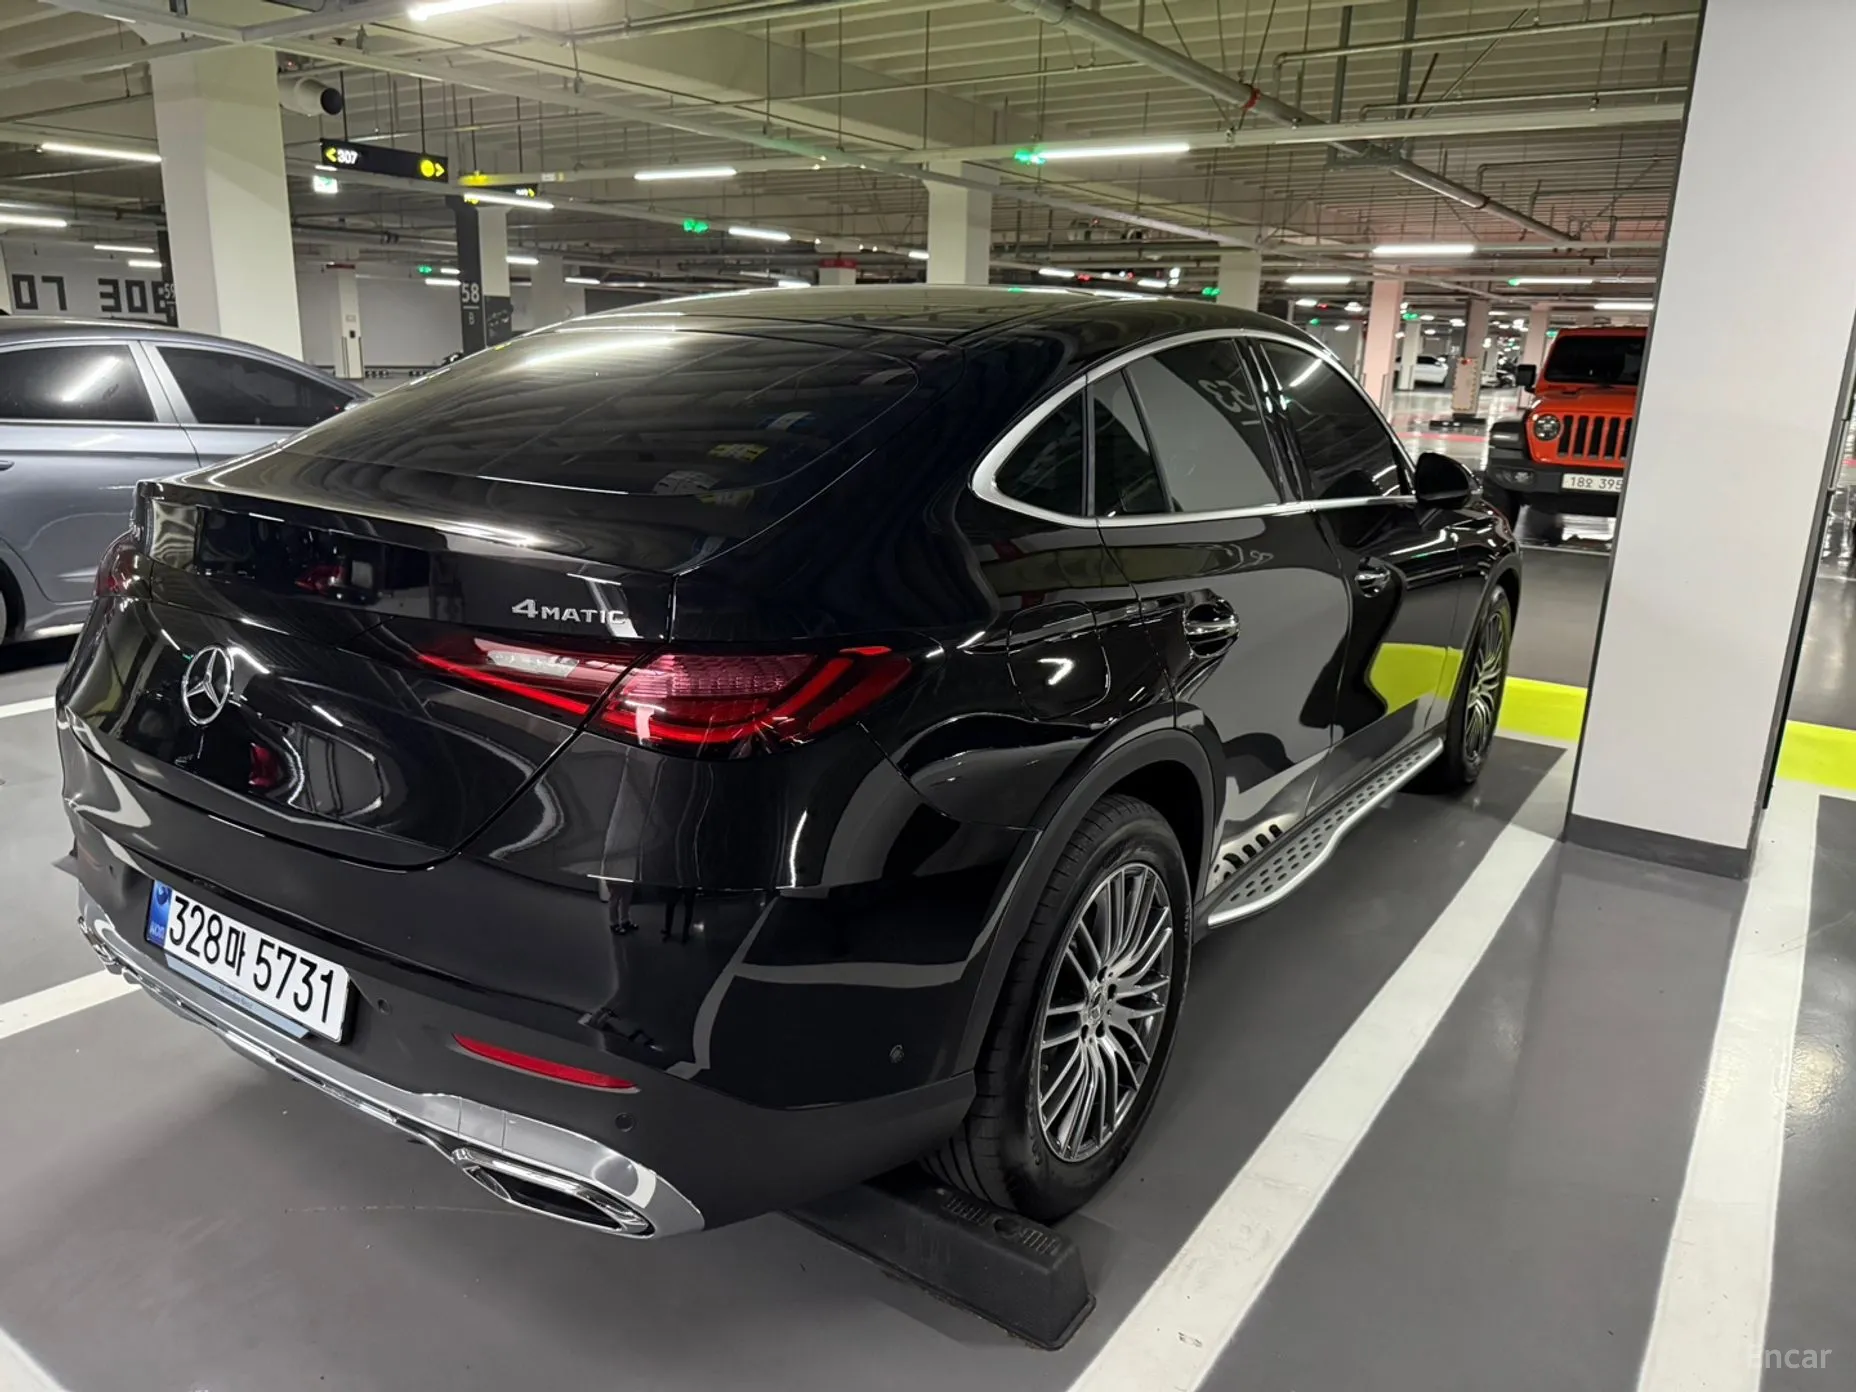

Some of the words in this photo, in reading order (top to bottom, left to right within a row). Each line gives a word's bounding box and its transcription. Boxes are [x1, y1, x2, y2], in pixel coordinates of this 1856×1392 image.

[337, 149, 358, 164] 307
[461, 282, 480, 304] 58
[511, 599, 626, 624] 4MATIC
[169, 895, 245, 977] 328마
[253, 937, 334, 1023] 5731
